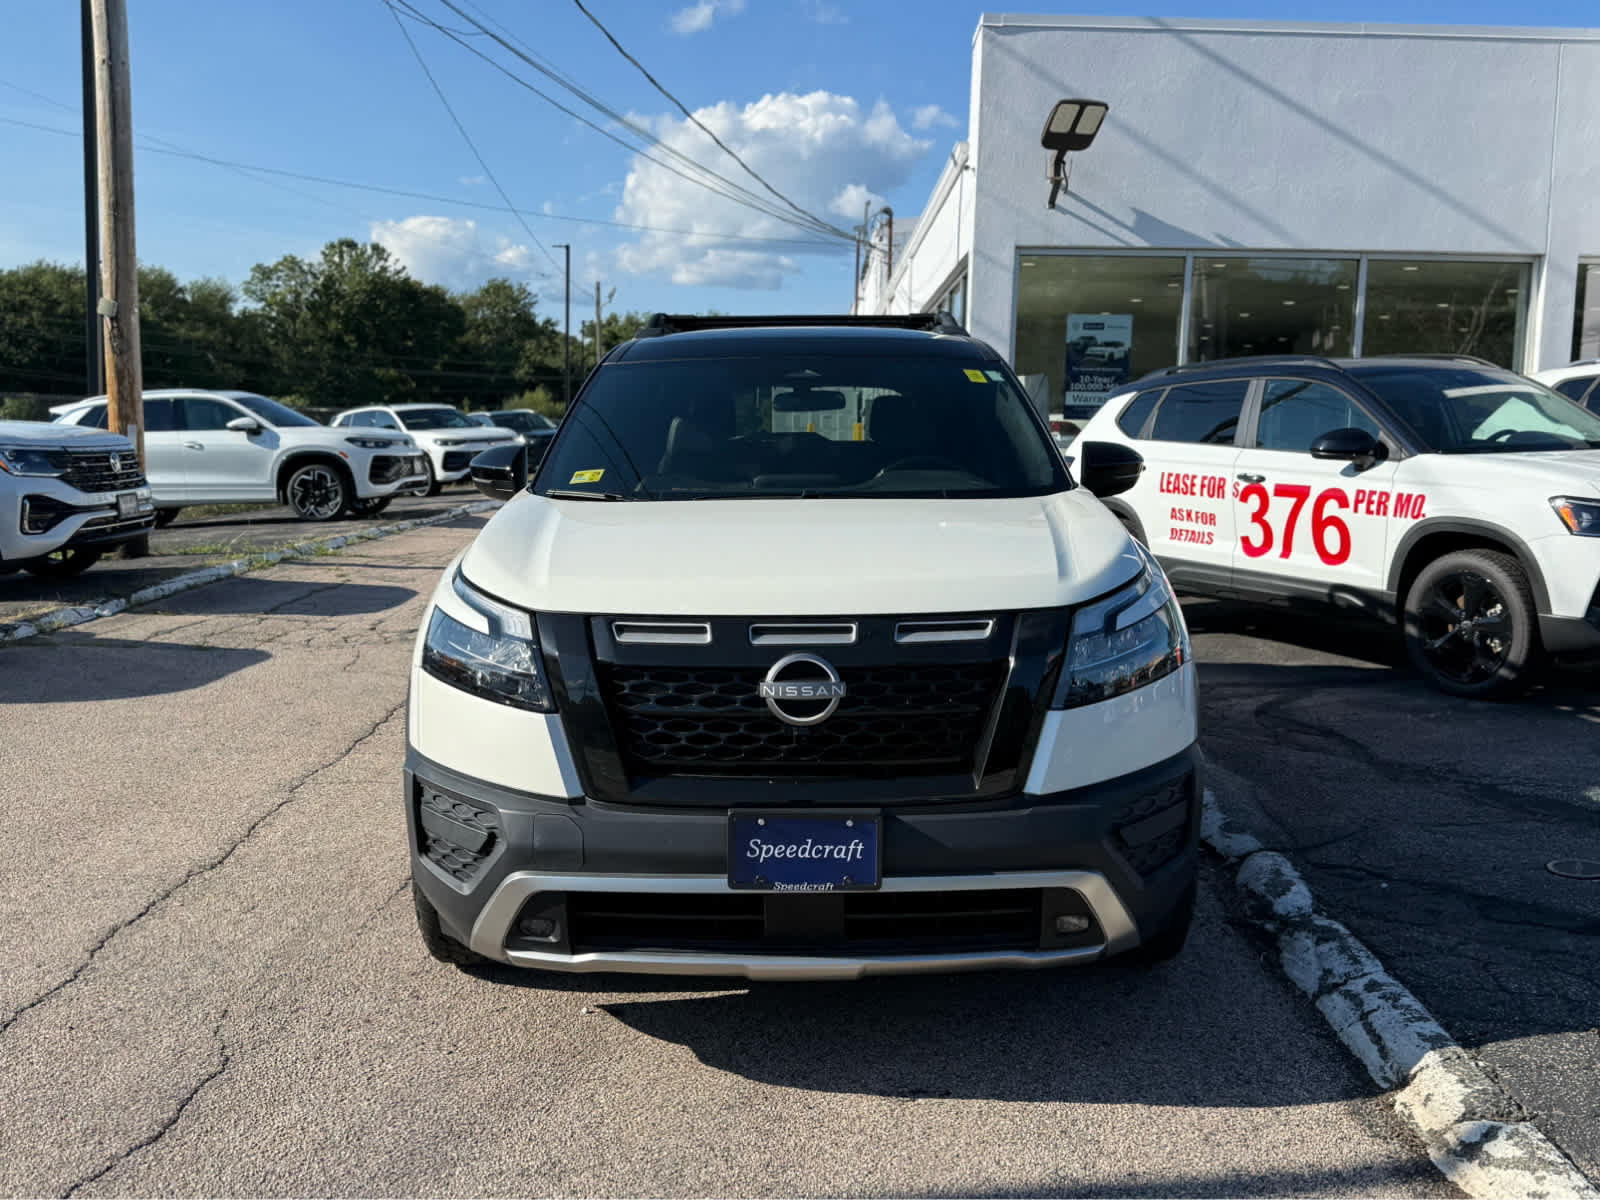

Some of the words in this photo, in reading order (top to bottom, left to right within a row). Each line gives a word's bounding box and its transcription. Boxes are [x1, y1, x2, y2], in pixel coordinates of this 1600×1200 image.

[1160, 472, 1197, 496] LEASE
[1200, 475, 1226, 499] FOR
[1353, 489, 1390, 516] PER
[1393, 493, 1426, 519] MO.
[1170, 507, 1193, 522] ASK
[1195, 511, 1216, 526] FOR
[1169, 528, 1214, 545] DETAILS
[762, 685, 844, 697] NISSAN
[746, 838, 865, 863] Speedcraft
[773, 882, 834, 892] Speedcraft
